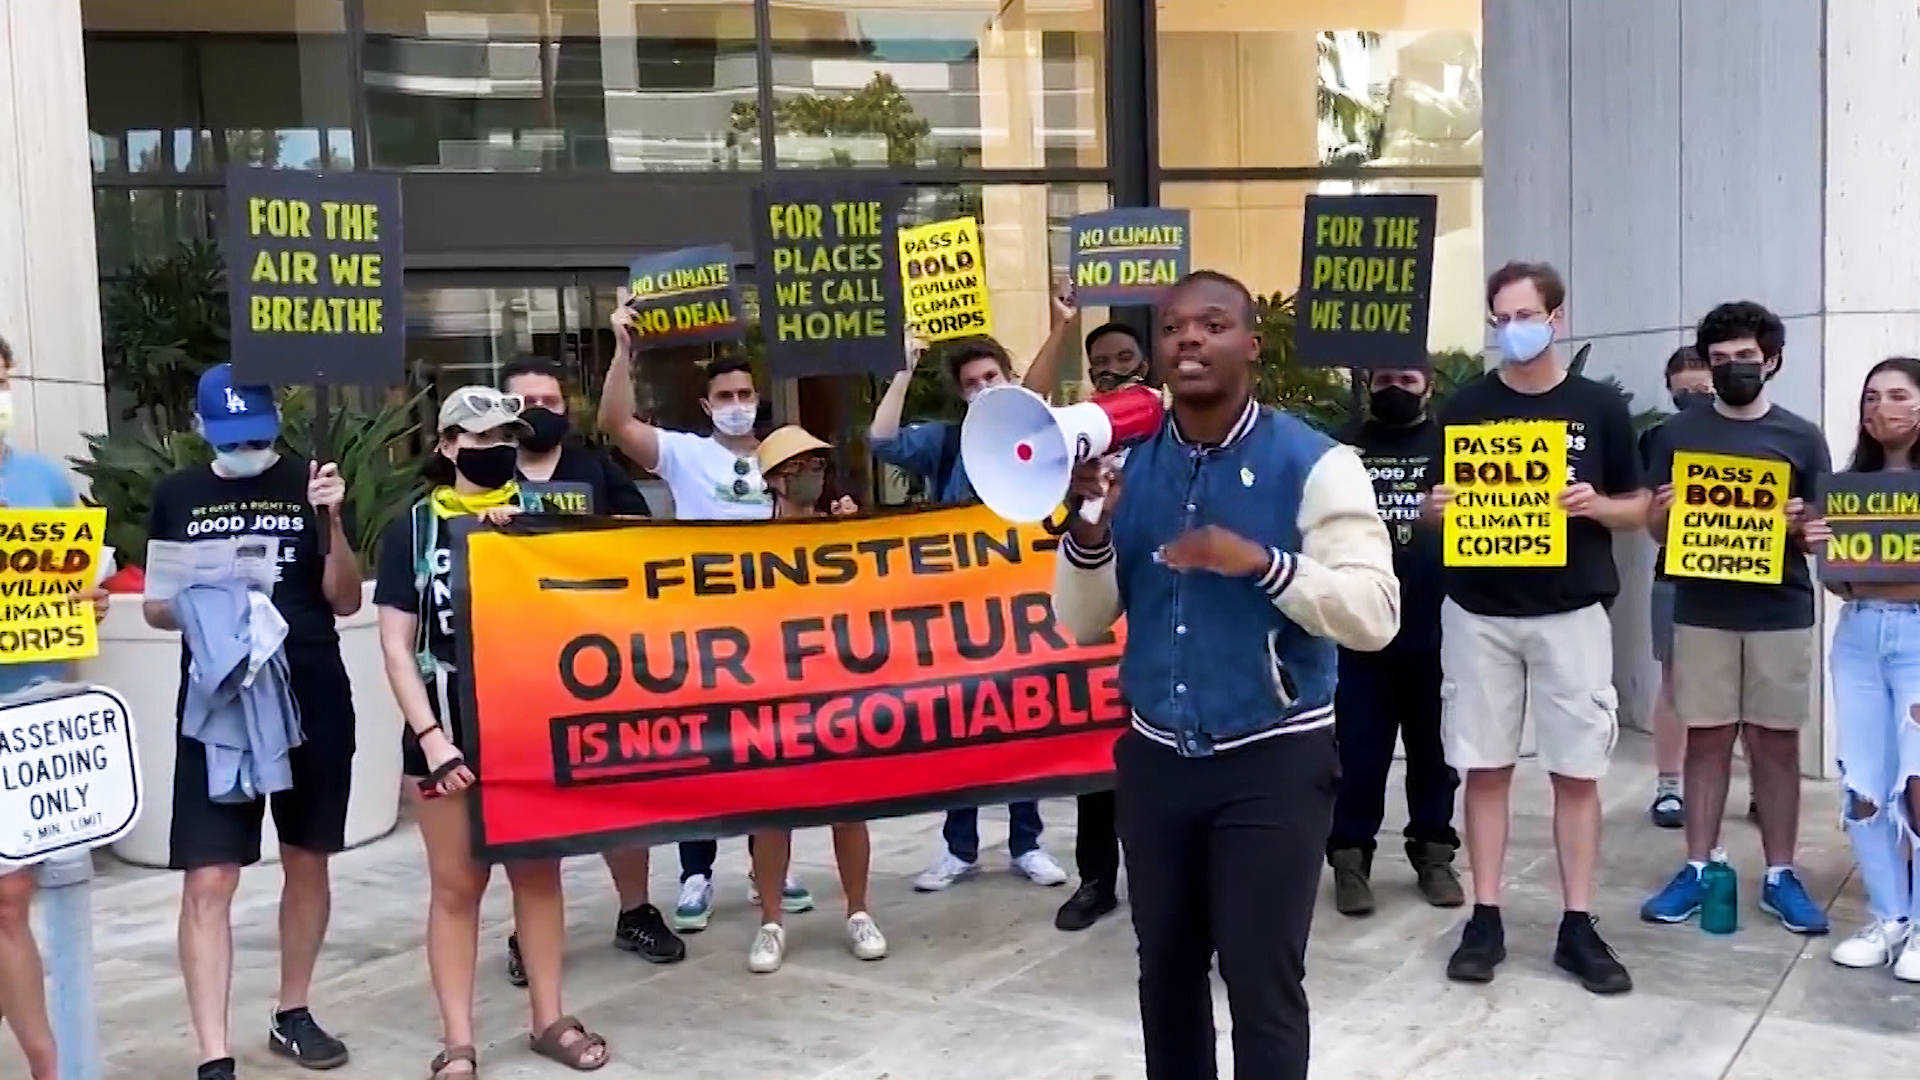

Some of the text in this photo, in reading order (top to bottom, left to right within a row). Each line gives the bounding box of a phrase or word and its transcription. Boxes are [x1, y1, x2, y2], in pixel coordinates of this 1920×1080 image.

[250, 197, 379, 243] FOR THE
[769, 201, 882, 240] FOR THE
[1316, 214, 1420, 249] FOR THE
[904, 229, 971, 254] PASS A
[1079, 225, 1184, 248] NO CLIMATE
[251, 250, 382, 288] AIR WE
[774, 243, 884, 275] PLACES
[907, 250, 974, 279] BOLD
[632, 263, 730, 296] NO CLIMATE
[911, 276, 977, 299] CIVILIAN
[1077, 260, 1113, 287] NO
[1312, 256, 1417, 293] PEOPLE
[776, 278, 885, 307] WE CALL
[912, 293, 981, 317] CLIMATE
[251, 295, 383, 335] BREATHE
[634, 299, 736, 336] NO DEAL
[777, 308, 888, 342] HOME
[1311, 299, 1412, 334] WE LOVE
[1453, 437, 1548, 455] PASS A
[1454, 461, 1550, 485] BOLD
[1687, 464, 1778, 485] PASS A
[1455, 492, 1550, 507] CIVILIAN
[1686, 485, 1776, 510] BOLD
[1827, 492, 1920, 513] NO CLIM
[73, 522, 93, 542] A
[187, 515, 304, 537] GOOD JOBS
[1456, 512, 1551, 529] CLIMATE
[1684, 512, 1774, 532] CIVILIAN
[1457, 534, 1551, 556] CORPS
[1682, 532, 1773, 552] CLIMATE
[1826, 533, 1920, 562] NO DE
[643, 527, 1022, 599] FEINSTEIN
[1682, 552, 1771, 575] CORPS
[0, 580, 83, 597] VILIAN
[0, 626, 86, 651] ORPS
[558, 591, 1117, 700] OUR FUTUR
[567, 664, 1125, 766] IS NOT NEGOTIABLE
[0, 708, 117, 754] ASSENGER
[2, 744, 107, 791] LOADING
[30, 782, 89, 820] ONLY
